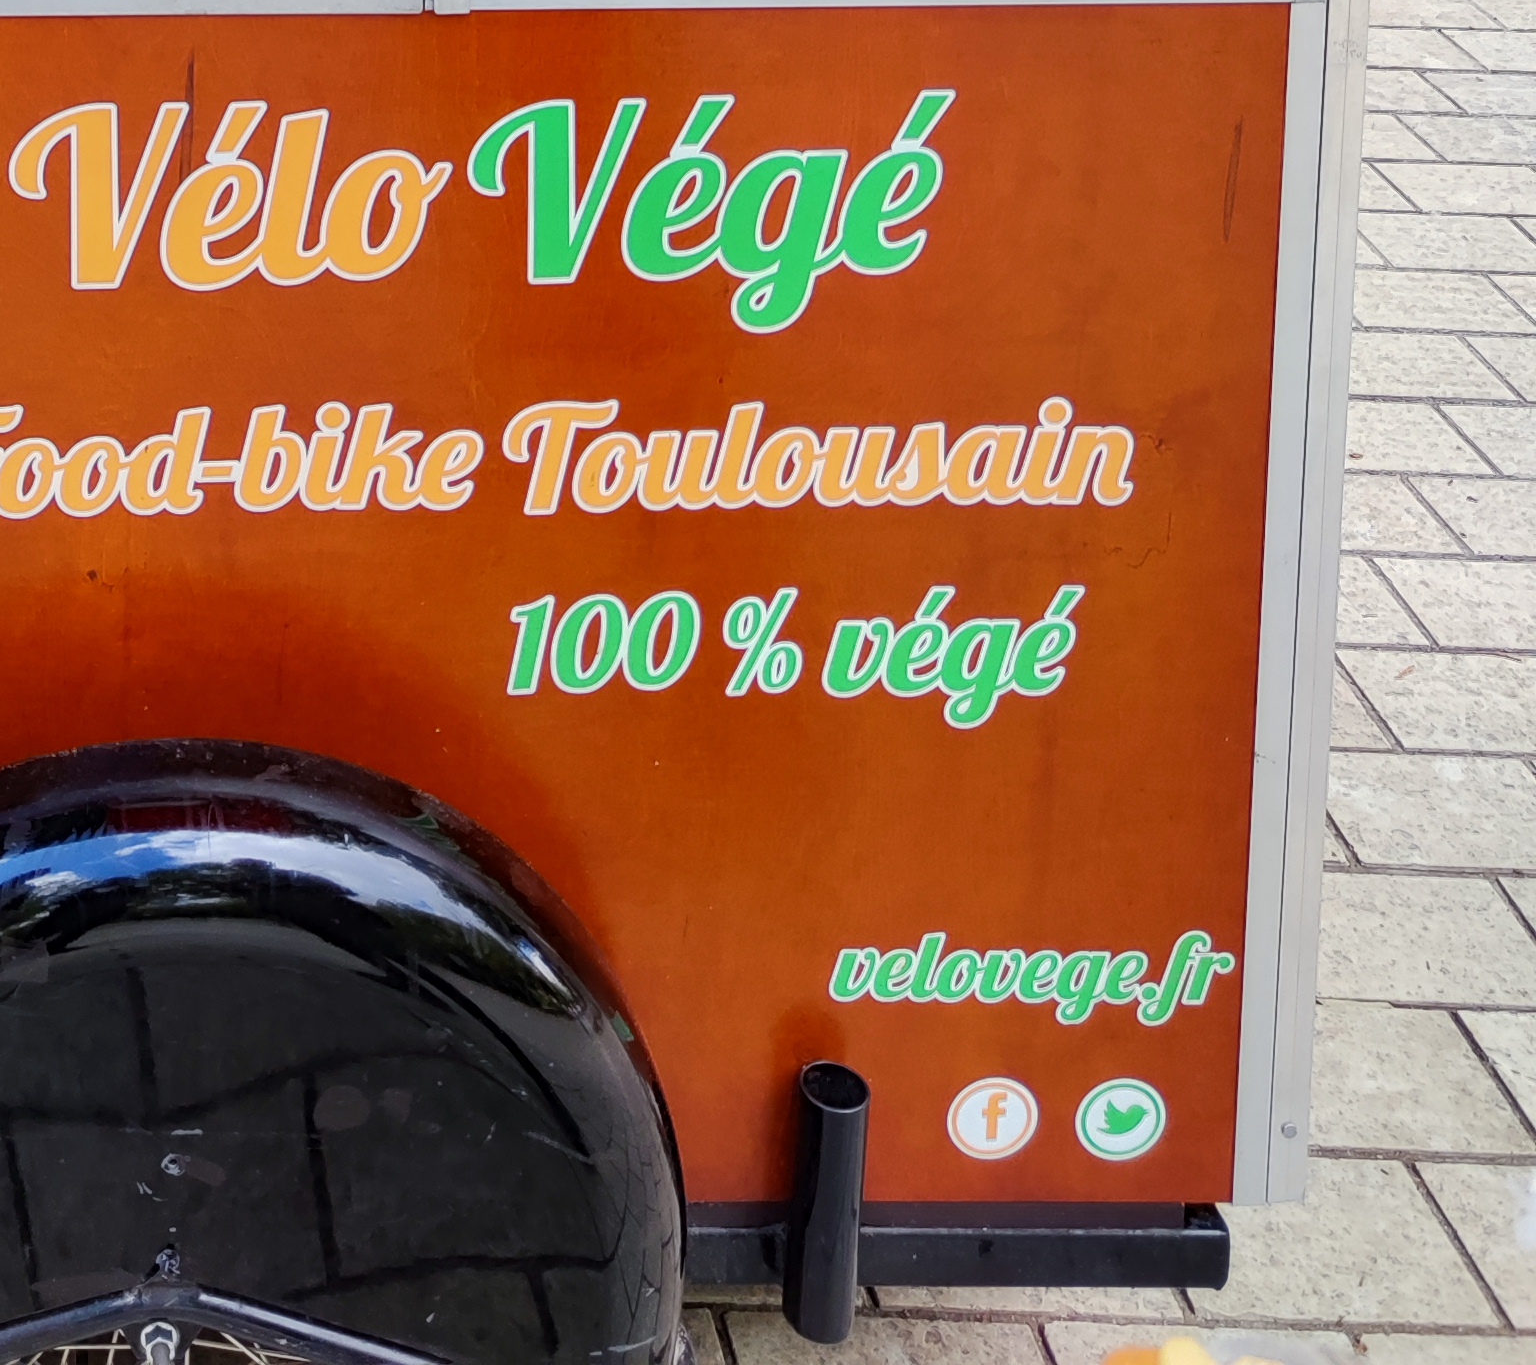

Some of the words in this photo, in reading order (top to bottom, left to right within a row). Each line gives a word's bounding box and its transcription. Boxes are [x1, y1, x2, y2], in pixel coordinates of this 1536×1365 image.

[7, 96, 454, 295] Vélo
[464, 86, 959, 337] Végé
[500, 394, 1136, 520] Toulousain
[504, 587, 703, 699] 100
[722, 583, 803, 701] %
[819, 581, 1087, 729] végé
[828, 929, 1236, 1027] velovege.fr
